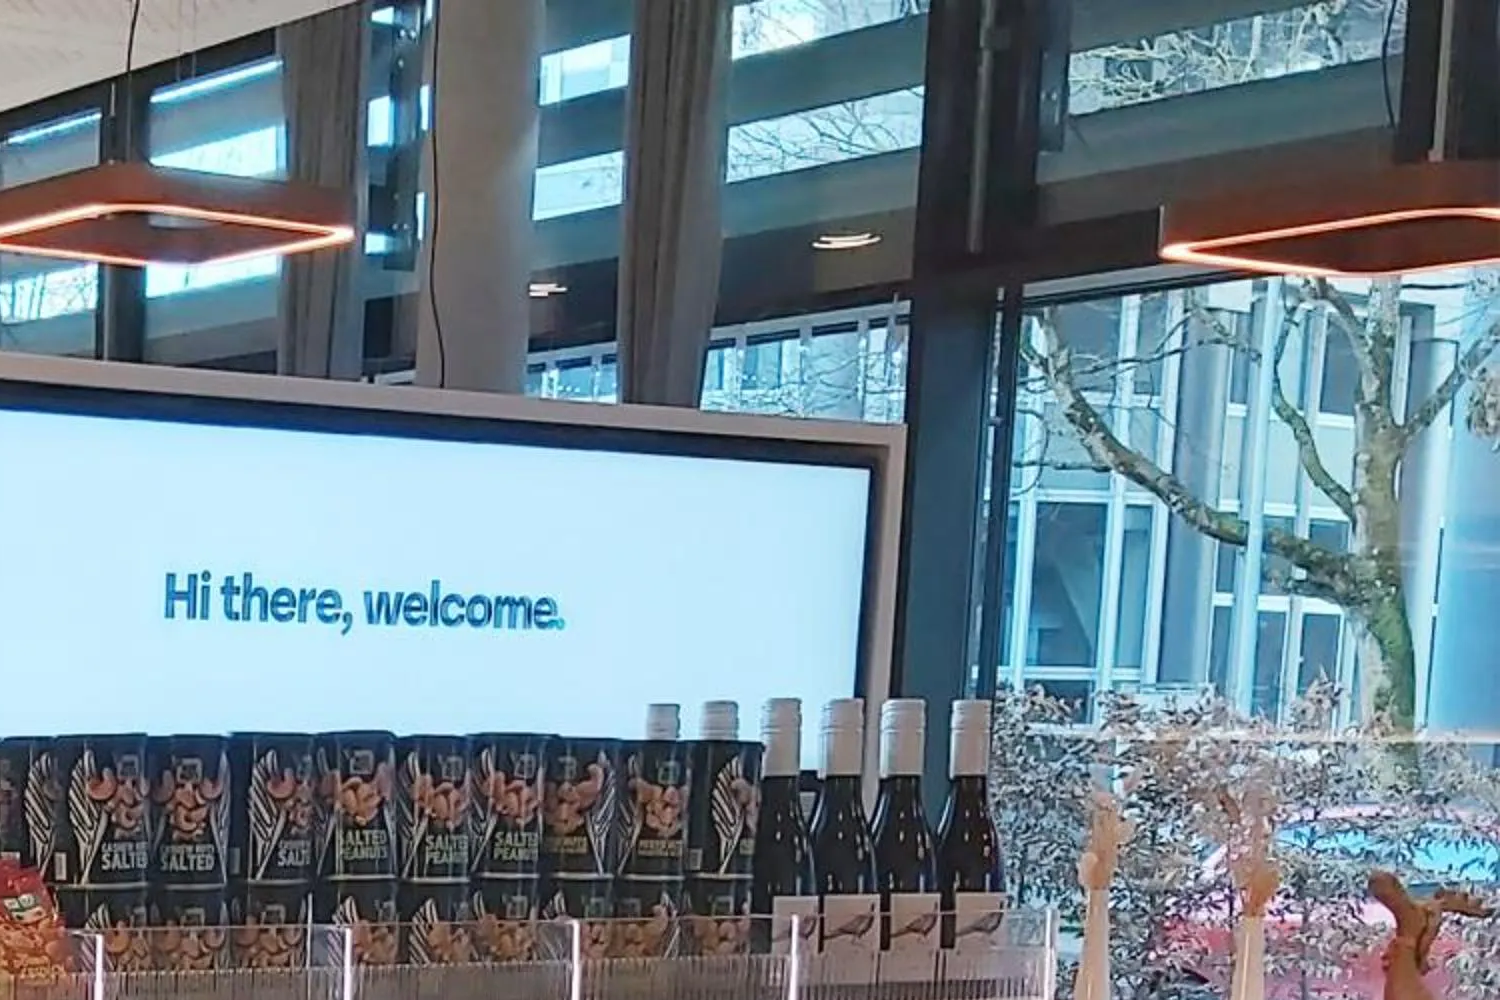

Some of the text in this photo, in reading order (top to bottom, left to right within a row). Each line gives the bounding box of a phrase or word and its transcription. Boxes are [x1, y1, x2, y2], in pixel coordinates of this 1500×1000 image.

[164, 570, 566, 636] Hi there, welcome.
[161, 853, 215, 872] SALTED
